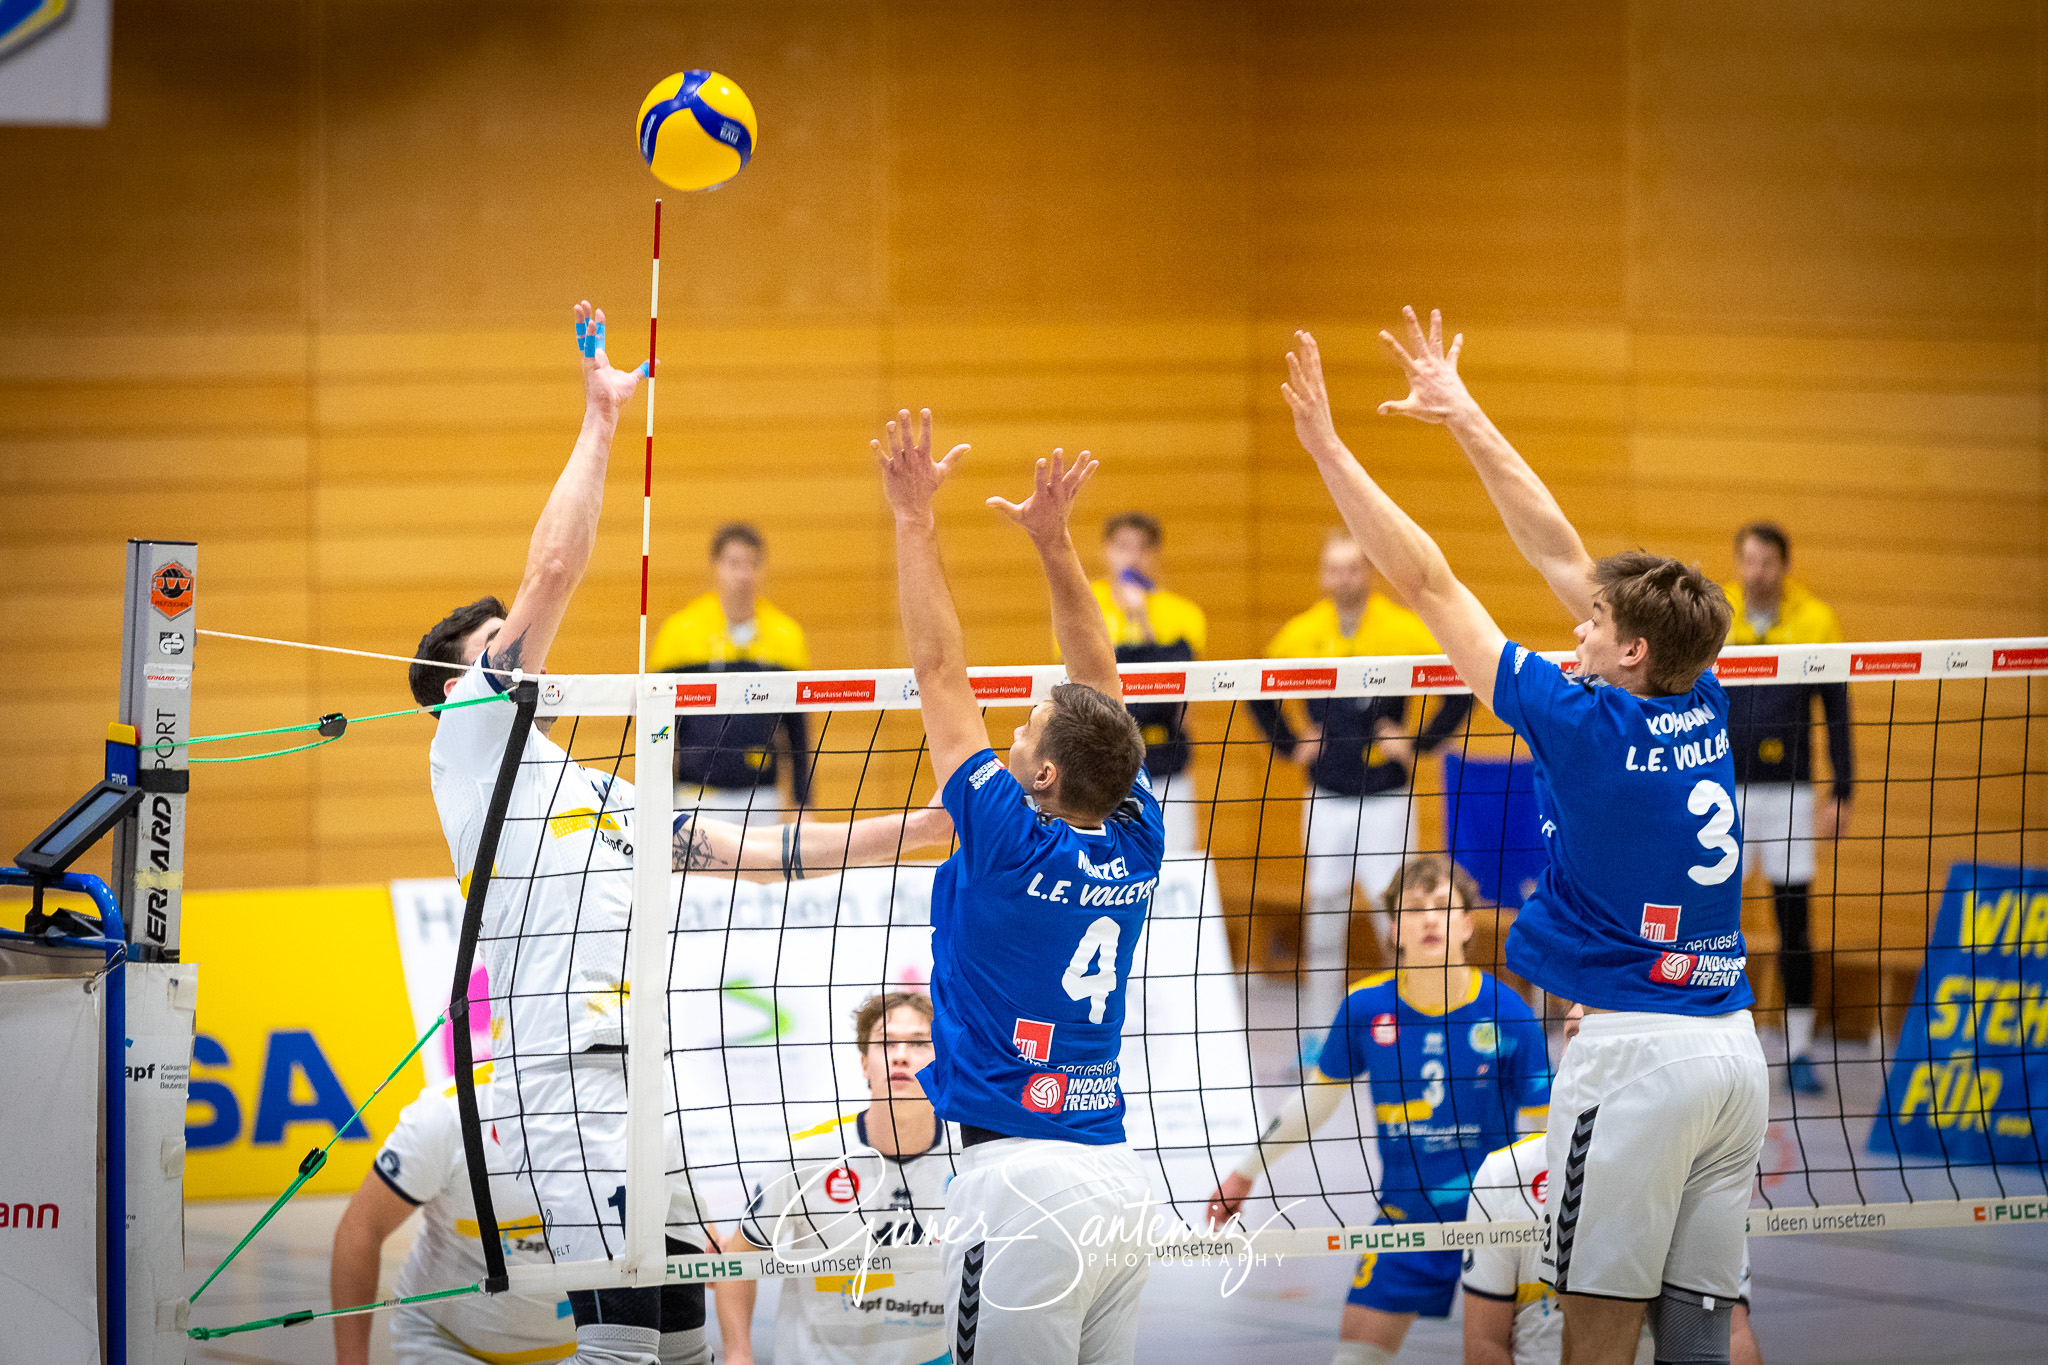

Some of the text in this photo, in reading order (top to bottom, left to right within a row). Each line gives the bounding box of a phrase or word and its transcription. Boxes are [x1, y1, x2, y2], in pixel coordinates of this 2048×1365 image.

[1721, 666, 1748, 675] Sparkasse
[1809, 664, 1825, 672] Zapf
[1865, 662, 1917, 670] Sparkasse Nürnberg
[1125, 682, 1180, 692] Sparkasse Nürnberg
[1218, 681, 1235, 689] Zapf
[1277, 678, 1332, 688] Sparkasse Nürnberg
[1369, 677, 1386, 685] Zapf
[684, 694, 711, 702] Nürnberg
[751, 693, 769, 702] Zapf
[813, 690, 870, 700] Sparkasse Nürnberg
[1000, 686, 1027, 694] Nürnberg
[155, 708, 176, 770] PORT
[1626, 745, 1668, 772] L.E.
[1687, 779, 1740, 886] 3
[1027, 872, 1072, 904] L.E.
[1080, 877, 1157, 906] VOLLEYS
[1062, 915, 1121, 1025] 4
[1696, 954, 1746, 971] INDOOR
[125, 1063, 155, 1082] apf
[1067, 1076, 1118, 1094] INDOOR
[1063, 1093, 1117, 1111] TRENDS
[1766, 1212, 1886, 1232] Ideen umsetzen
[1350, 1226, 1545, 1249] FUCHS Ideen umsetz
[1156, 1239, 1234, 1258] umsetzen
[885, 1299, 945, 1317] Daigfus
